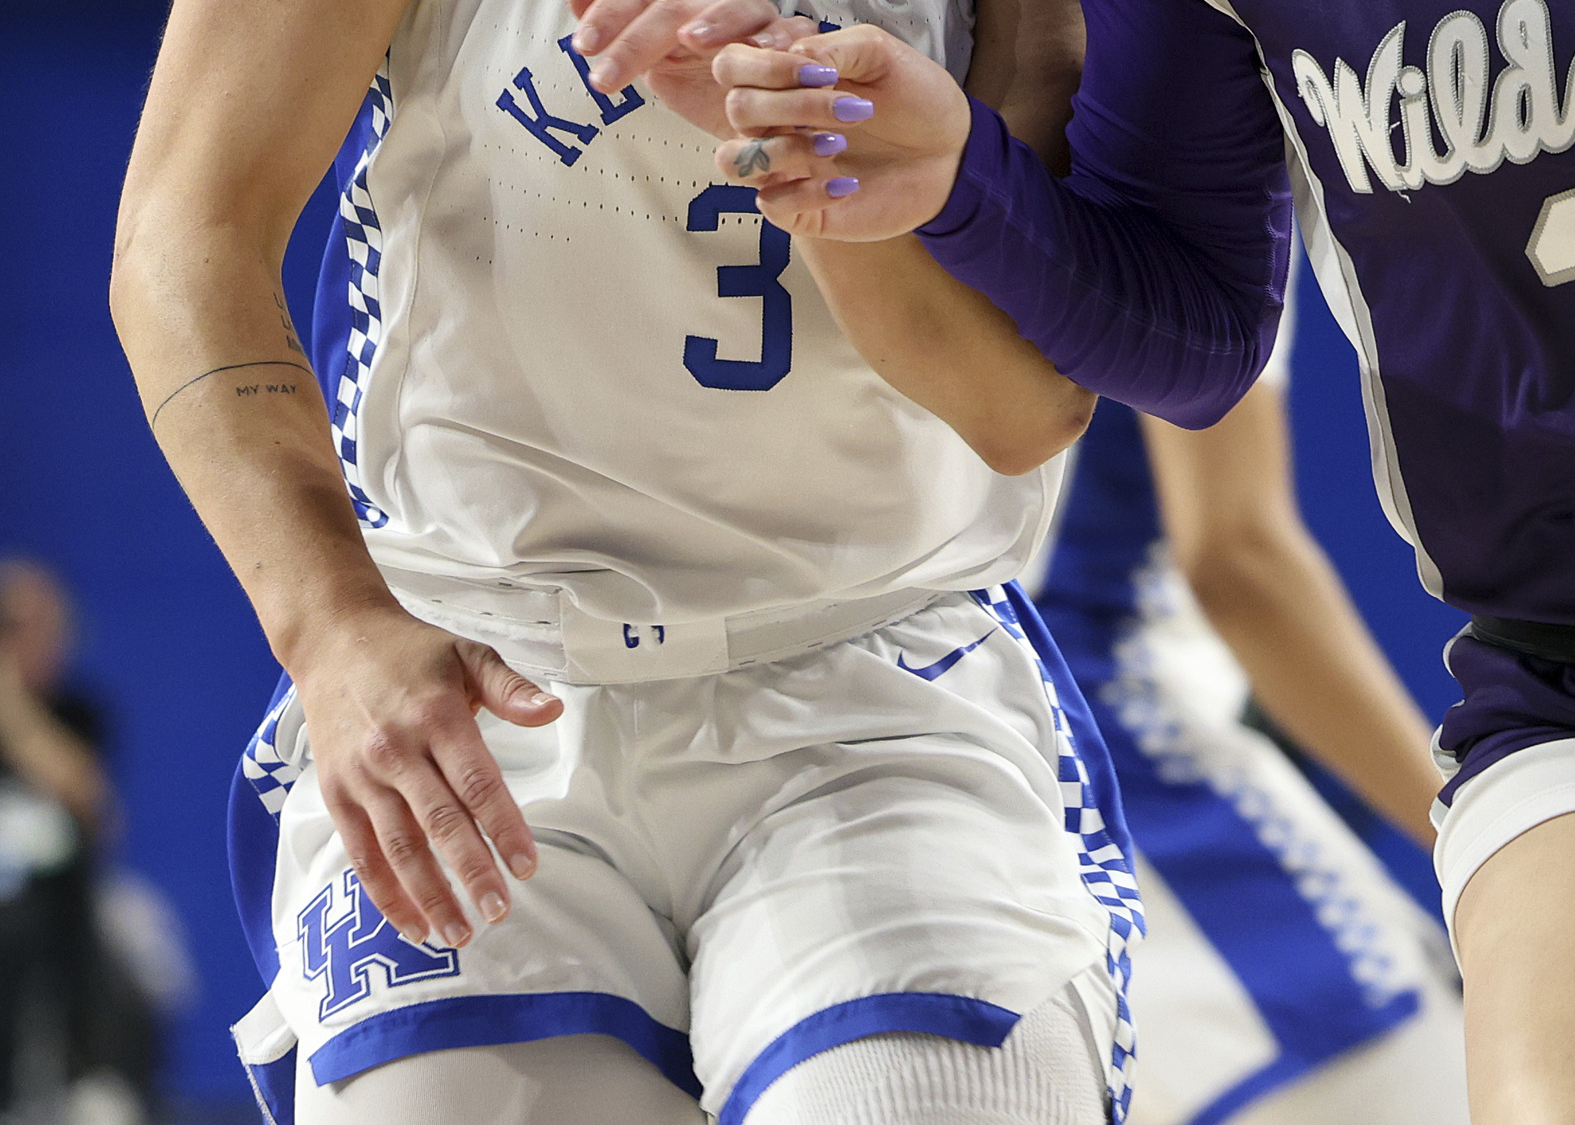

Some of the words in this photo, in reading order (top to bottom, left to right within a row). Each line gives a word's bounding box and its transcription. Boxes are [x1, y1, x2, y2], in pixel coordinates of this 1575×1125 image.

[683, 184, 792, 392] 3
[236, 385, 259, 397] MY
[265, 384, 297, 395] WAY
